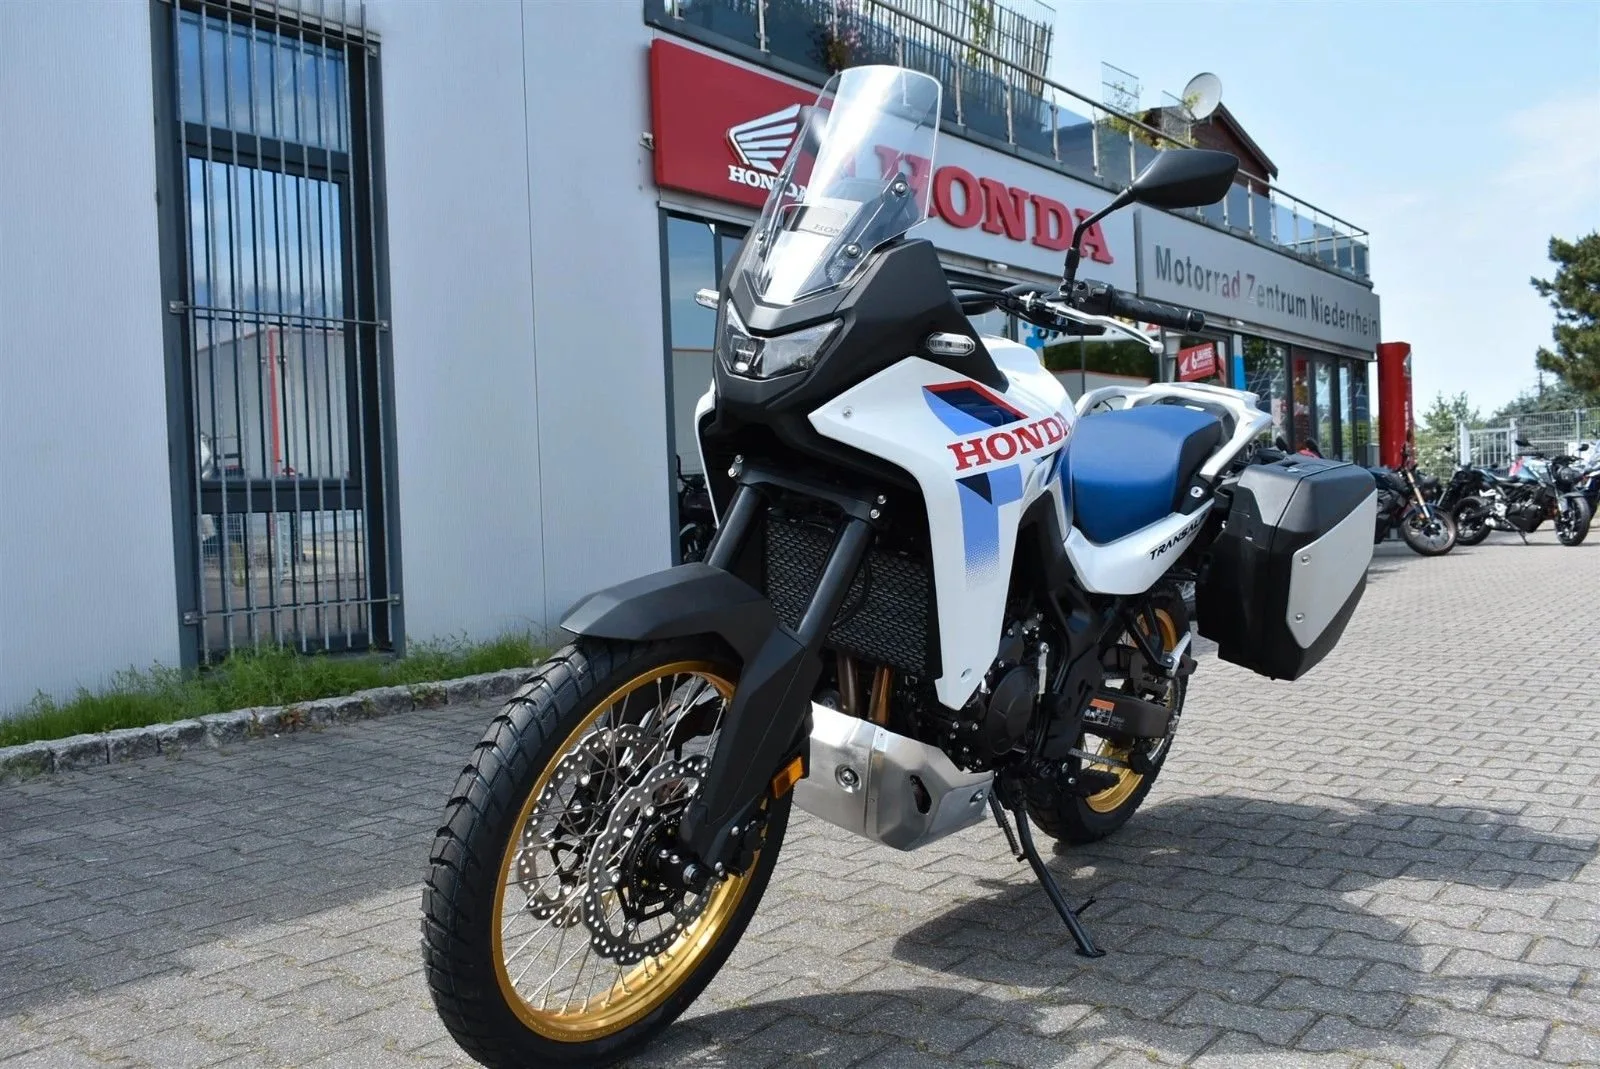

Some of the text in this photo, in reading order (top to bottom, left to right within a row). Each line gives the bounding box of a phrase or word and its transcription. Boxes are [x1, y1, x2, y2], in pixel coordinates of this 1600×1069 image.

[874, 144, 1113, 264] HONDA
[1155, 244, 1378, 339] Motorrad Zentrum Niederrhein
[946, 411, 1071, 472] HONDA
